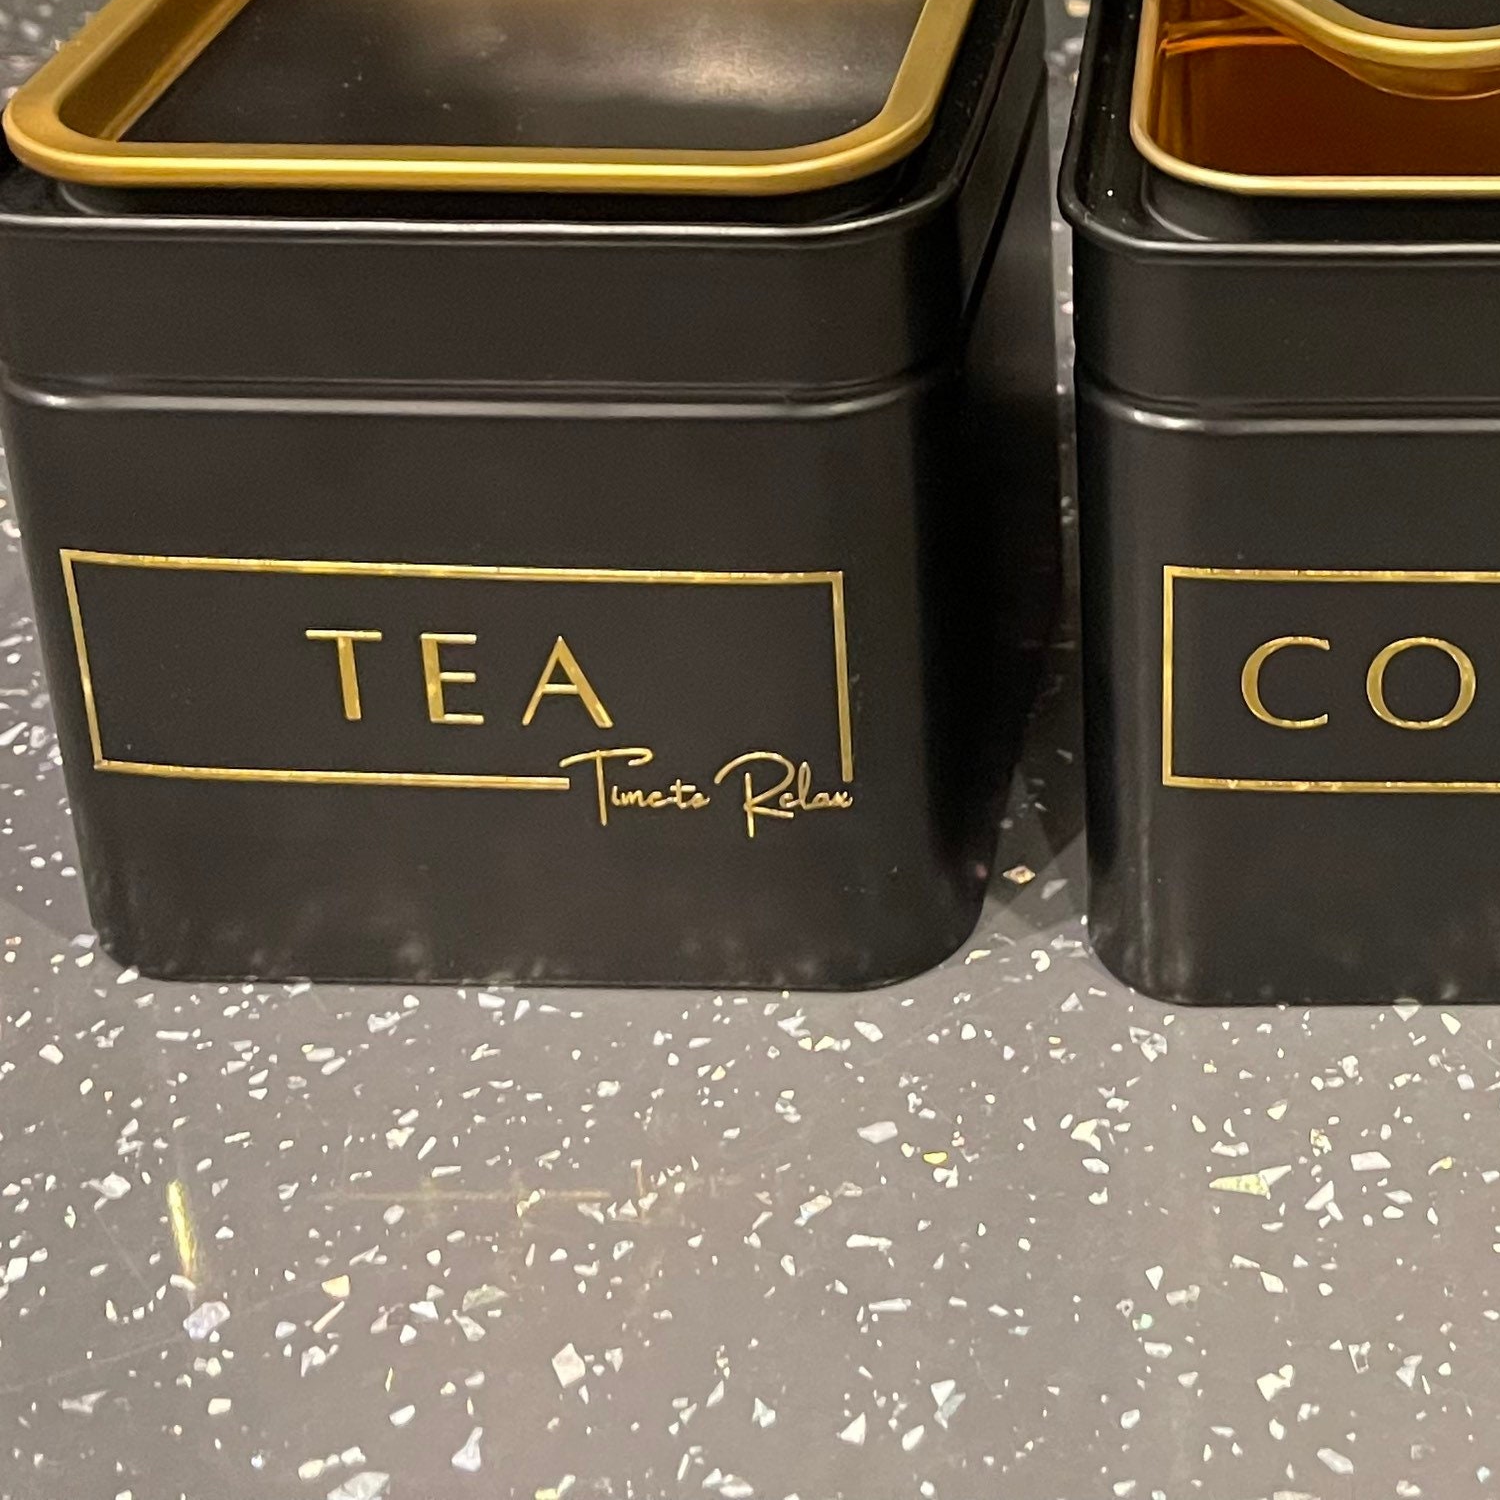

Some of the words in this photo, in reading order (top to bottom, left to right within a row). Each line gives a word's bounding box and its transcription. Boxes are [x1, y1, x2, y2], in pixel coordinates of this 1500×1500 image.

[305, 628, 614, 729] TEA
[558, 747, 665, 826] Time
[669, 778, 710, 809] to
[713, 751, 853, 838] Relax
